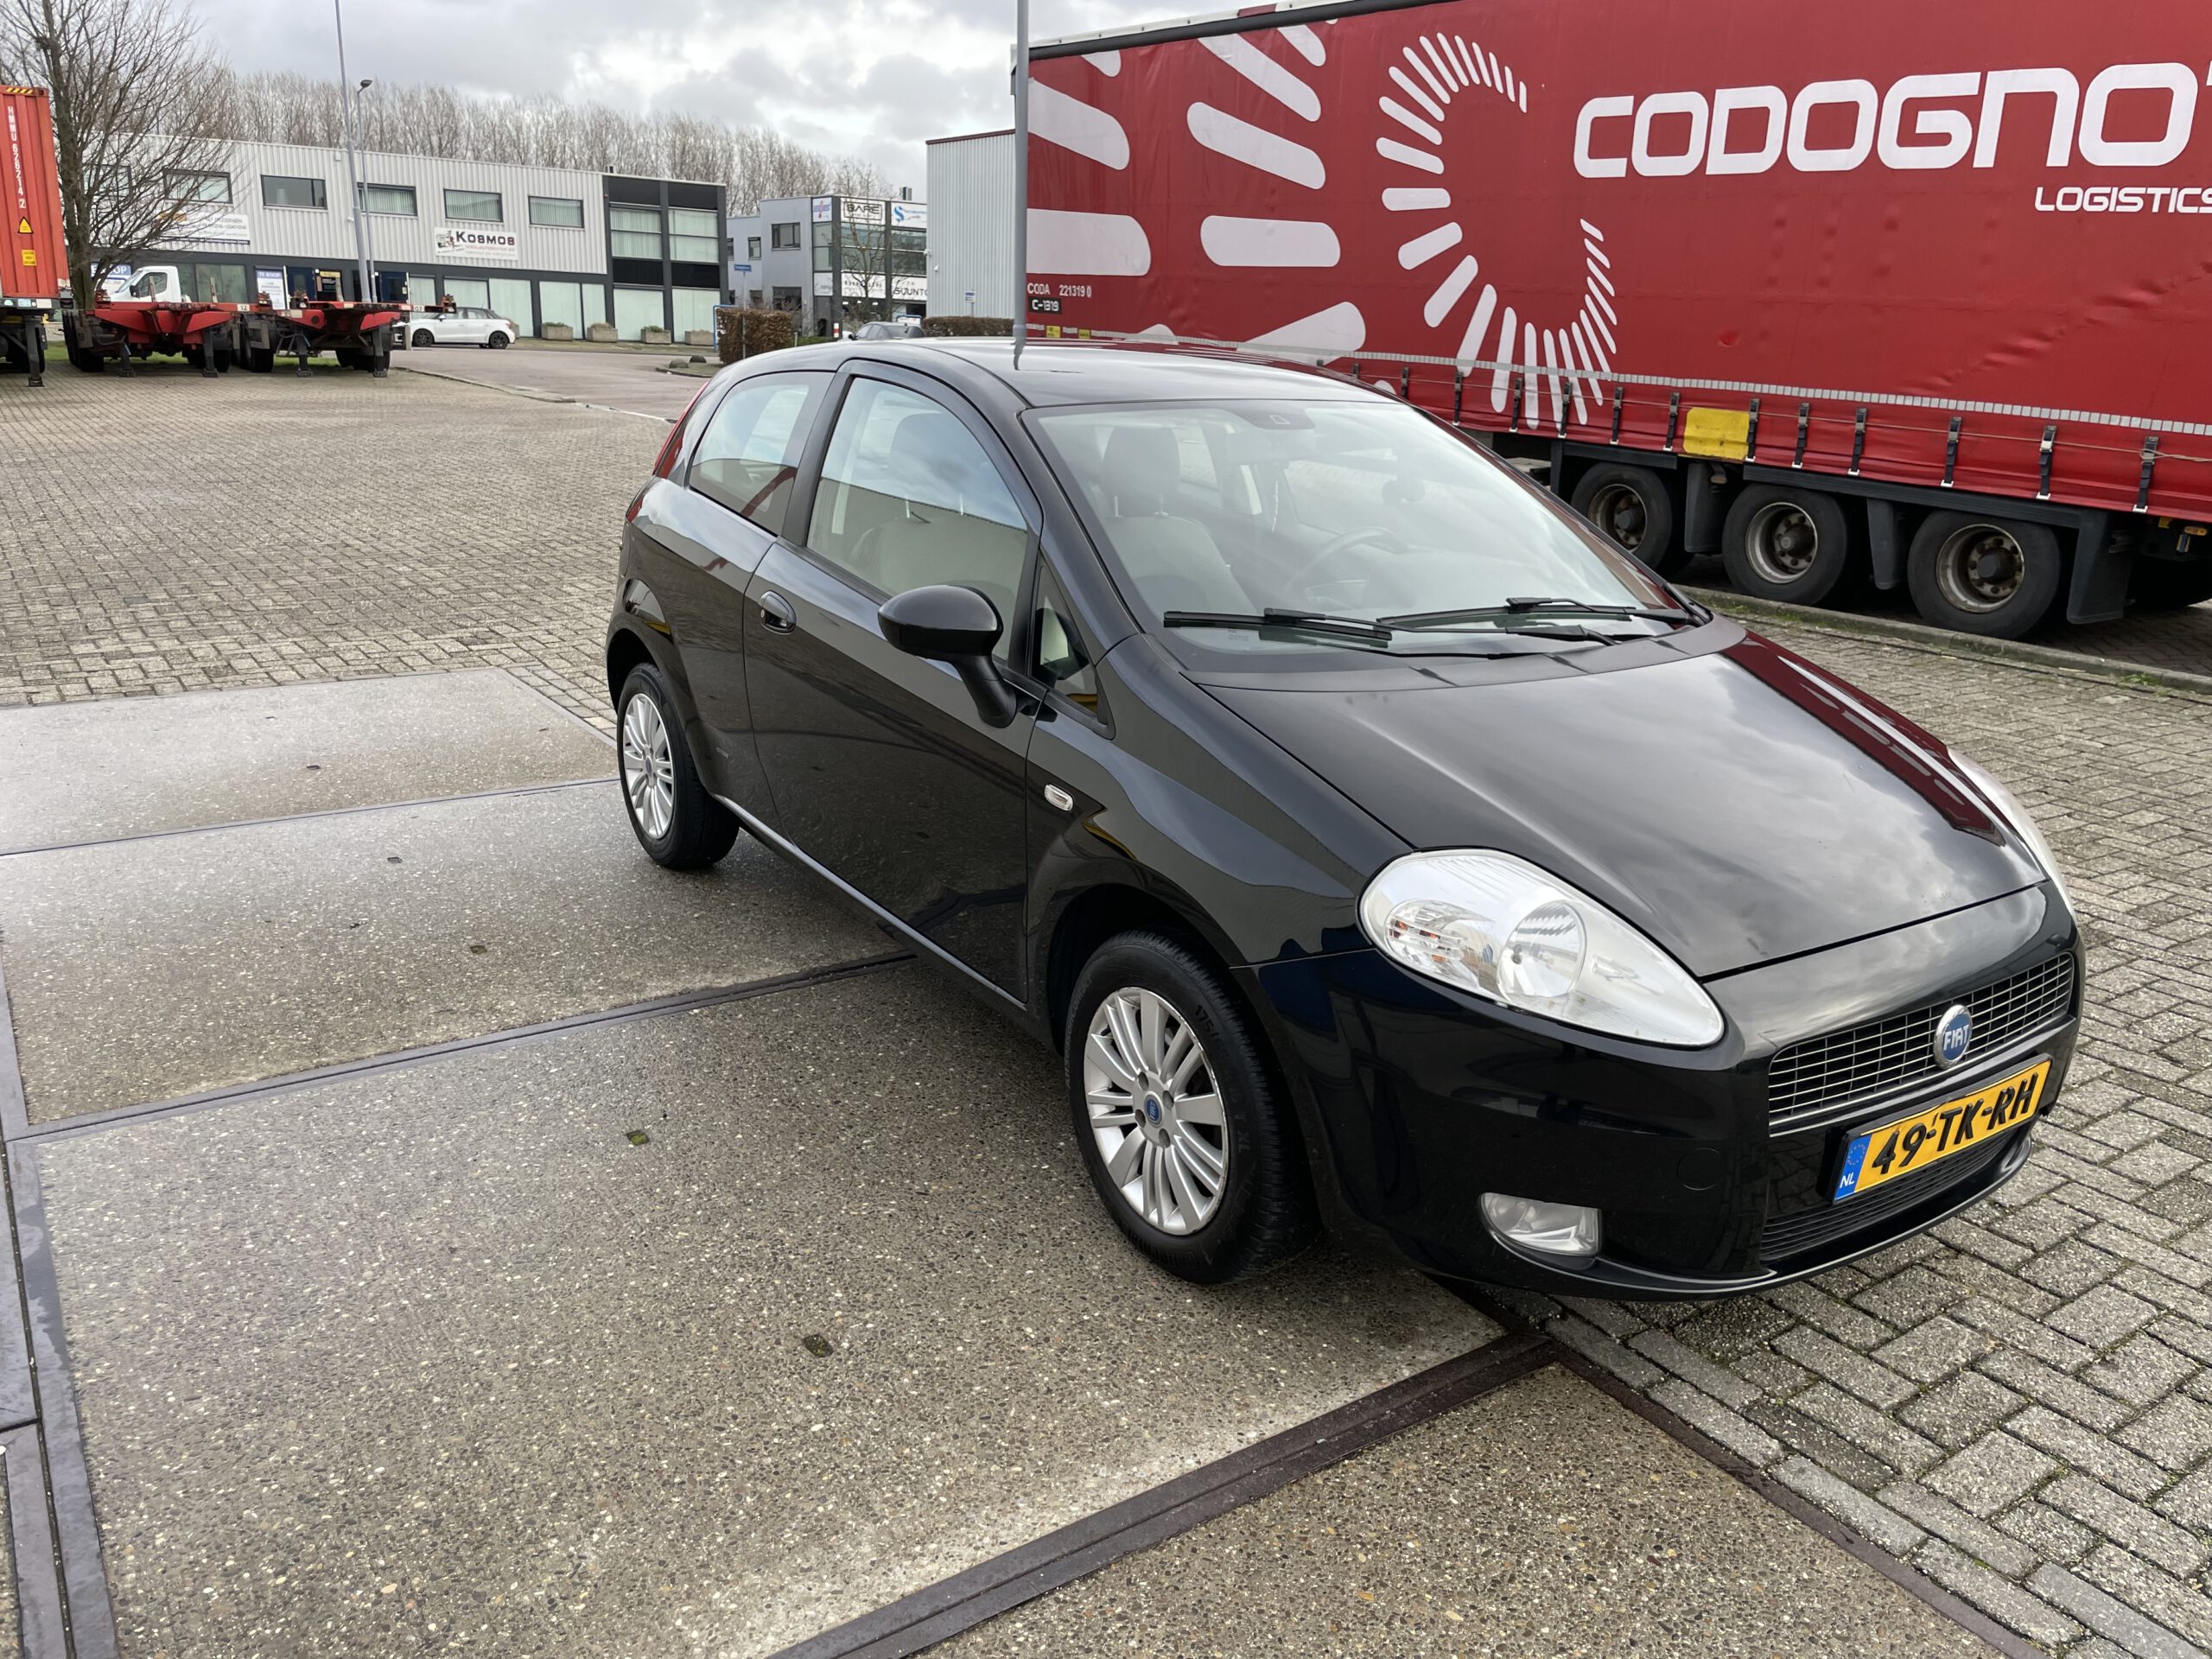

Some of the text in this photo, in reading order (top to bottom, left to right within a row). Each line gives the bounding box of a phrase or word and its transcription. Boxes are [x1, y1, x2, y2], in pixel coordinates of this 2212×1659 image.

[1573, 61, 2212, 178] CODOGNO
[8, 105, 16, 141] HMMU
[12, 143, 23, 196] 626214
[1027, 283, 1051, 295] CODA
[1032, 299, 1059, 312] C-1319
[1943, 1024, 1970, 1052] FIAT
[1872, 1072, 2039, 1175] 49-TK-RH
[1840, 1171, 1856, 1189] NL
